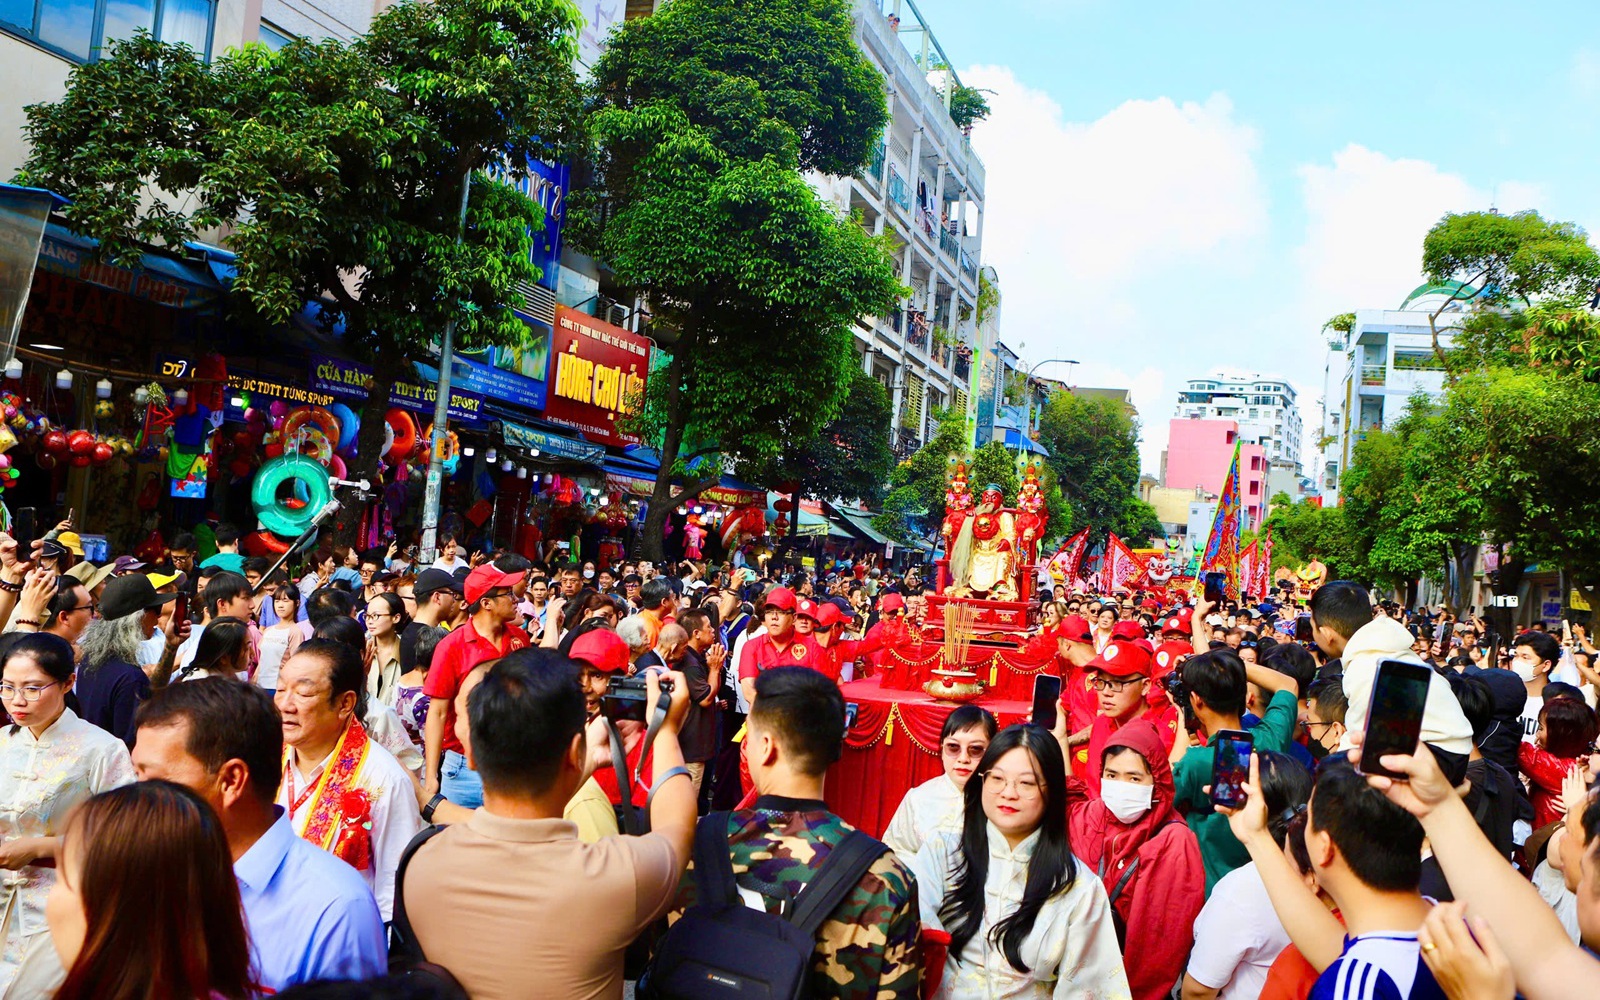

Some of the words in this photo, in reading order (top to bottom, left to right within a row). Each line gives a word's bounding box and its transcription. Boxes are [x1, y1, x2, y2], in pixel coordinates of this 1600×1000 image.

[573, 322, 579, 332] TY
[316, 360, 342, 382] CỬA
[343, 368, 375, 387] HÀN
[554, 339, 594, 405] HỒNG
[592, 363, 621, 420] CHỢ
[242, 379, 256, 392] DC
[257, 381, 282, 397] TDTT
[283, 386, 307, 402] TÙNG
[307, 392, 335, 406] SPORT
[394, 381, 421, 399] TDTT
[450, 394, 481, 412] SPORT
